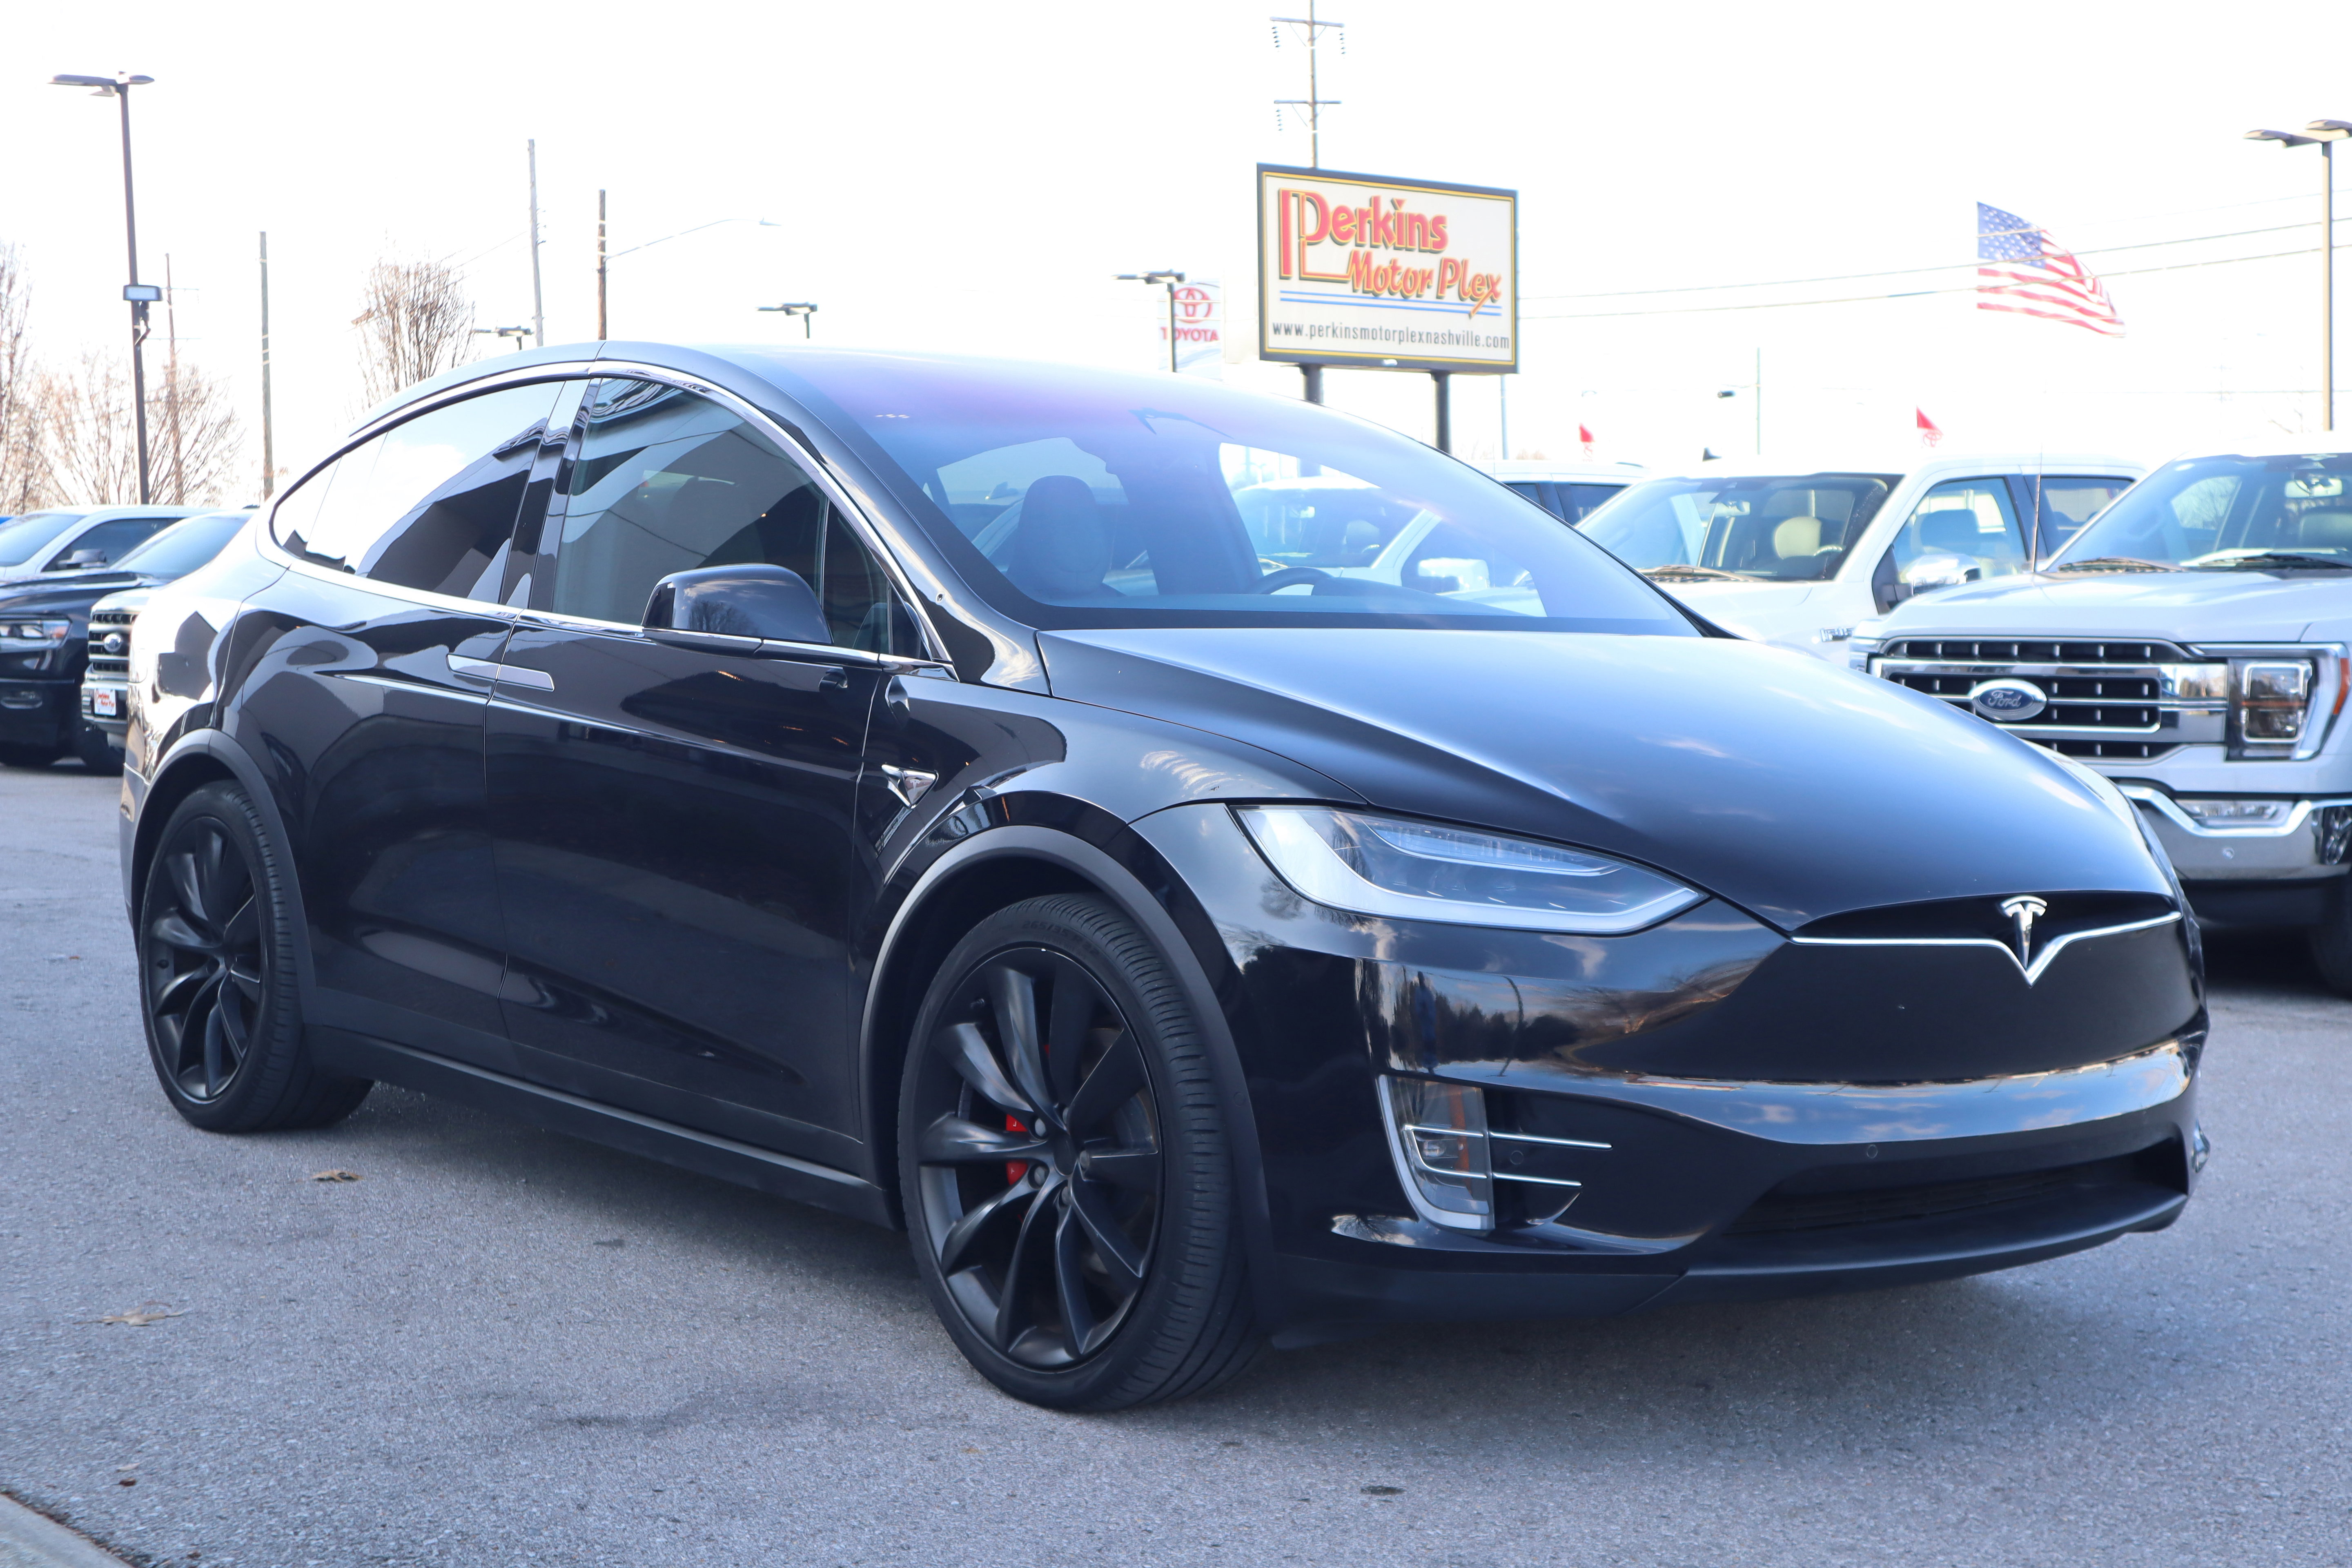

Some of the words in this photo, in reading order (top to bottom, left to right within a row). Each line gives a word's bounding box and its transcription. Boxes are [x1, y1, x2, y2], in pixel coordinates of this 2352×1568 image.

[1278, 188, 1449, 280] Perkins
[1348, 248, 1434, 299] Motor
[1437, 256, 1503, 319] Plex
[1160, 326, 1220, 342] TOYOTA
[1272, 321, 1510, 349] www.perkinsmotorplexnashville.com
[1988, 690, 2022, 707] Ford
